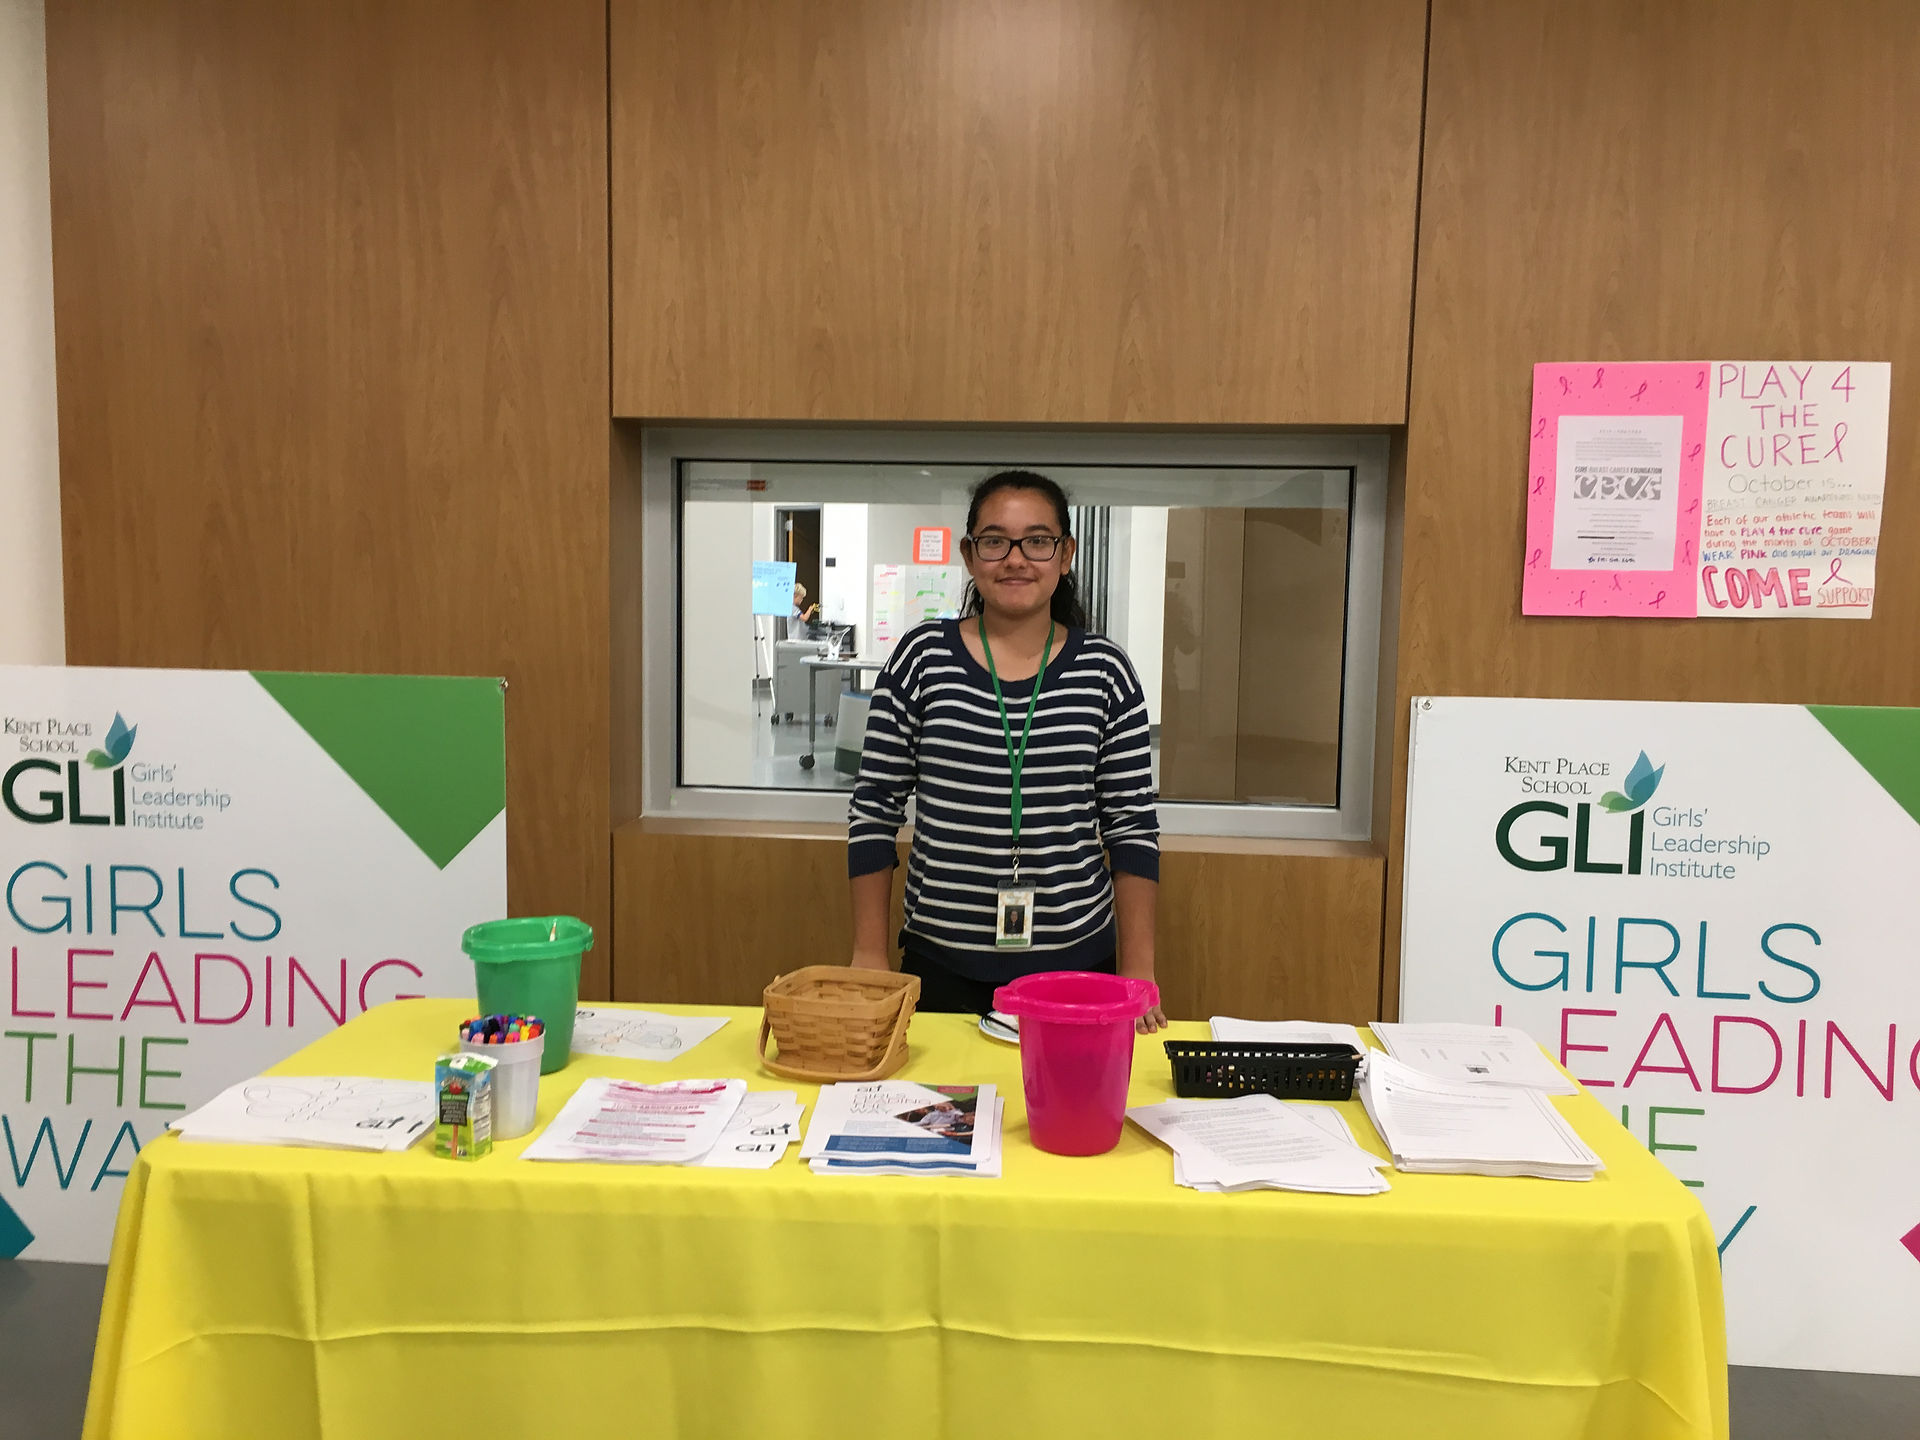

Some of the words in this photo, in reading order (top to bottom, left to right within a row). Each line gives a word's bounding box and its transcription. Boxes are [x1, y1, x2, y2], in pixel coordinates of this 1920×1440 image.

[1719, 363, 1813, 401] PLAY
[1830, 365, 1857, 403] 4
[1750, 403, 1820, 431] THE
[1720, 433, 1820, 469] CURE
[1728, 472, 1812, 494] October
[1706, 514, 1731, 527] Each
[1735, 514, 1748, 525] of
[1752, 515, 1769, 524] our
[1775, 511, 1816, 523] athletic
[1822, 509, 1853, 519] teams
[1857, 510, 1876, 520] will
[1703, 528, 1725, 537] have
[1729, 529, 1737, 537] a
[1740, 527, 1765, 537] PLAY
[1768, 526, 1776, 536] 4
[1779, 526, 1796, 536] the
[1827, 526, 1853, 537] game
[1705, 540, 1737, 551] during
[1763, 539, 1797, 547] month
[1803, 537, 1813, 546] of
[1820, 536, 1877, 547] OCTOBER!
[1702, 551, 1733, 562] WEAR
[1701, 565, 1812, 610] COME
[3, 717, 41, 736] KENT
[46, 719, 92, 737] PLACE
[19, 736, 80, 753] SCHOOL
[131, 763, 177, 783] Girls'
[1504, 756, 1551, 776] KENT
[1556, 758, 1611, 777] PLACE
[1, 758, 127, 826] GLI
[1521, 777, 1592, 796] SCHOOL
[132, 788, 231, 812] Leadership
[132, 810, 204, 830] Institute
[1653, 806, 1709, 828] Girls'
[1495, 800, 1645, 875] GLI
[1651, 832, 1771, 860] Leadership
[1649, 858, 1737, 880] Institute
[6, 861, 282, 941] GIRLS
[1491, 912, 1822, 1004] GIRLS
[1494, 1003, 1920, 1103] EADIN
[4, 1031, 189, 1110] THE
[2, 1115, 172, 1193] WA
